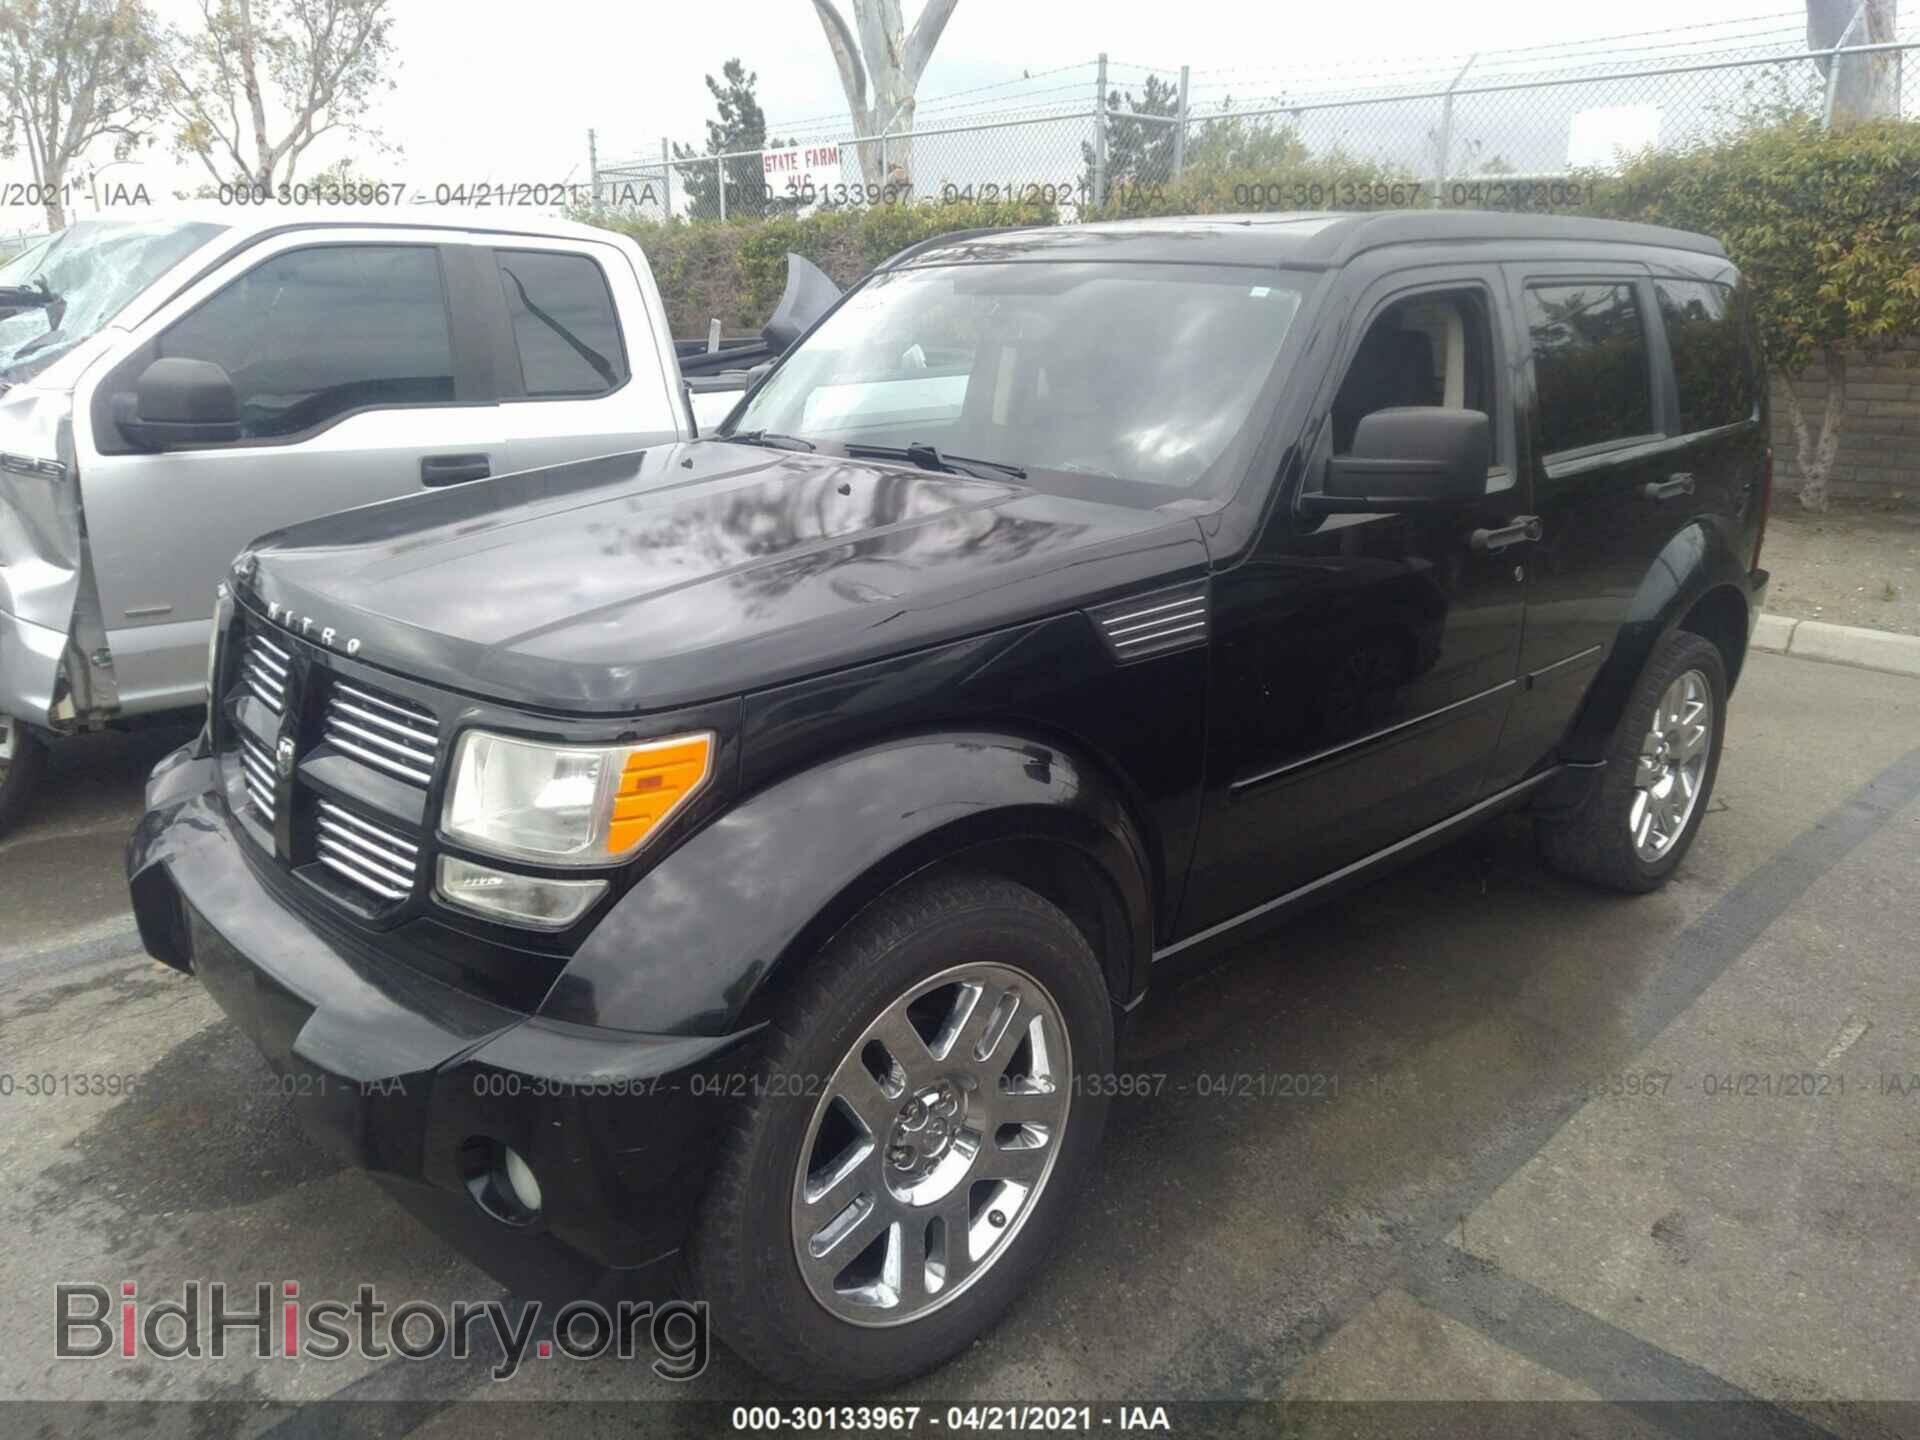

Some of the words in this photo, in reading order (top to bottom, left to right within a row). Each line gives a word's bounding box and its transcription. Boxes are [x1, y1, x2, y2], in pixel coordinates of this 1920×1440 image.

[764, 152, 798, 173] STATE
[805, 147, 838, 168] FARM
[267, 601, 361, 654] NITRO
